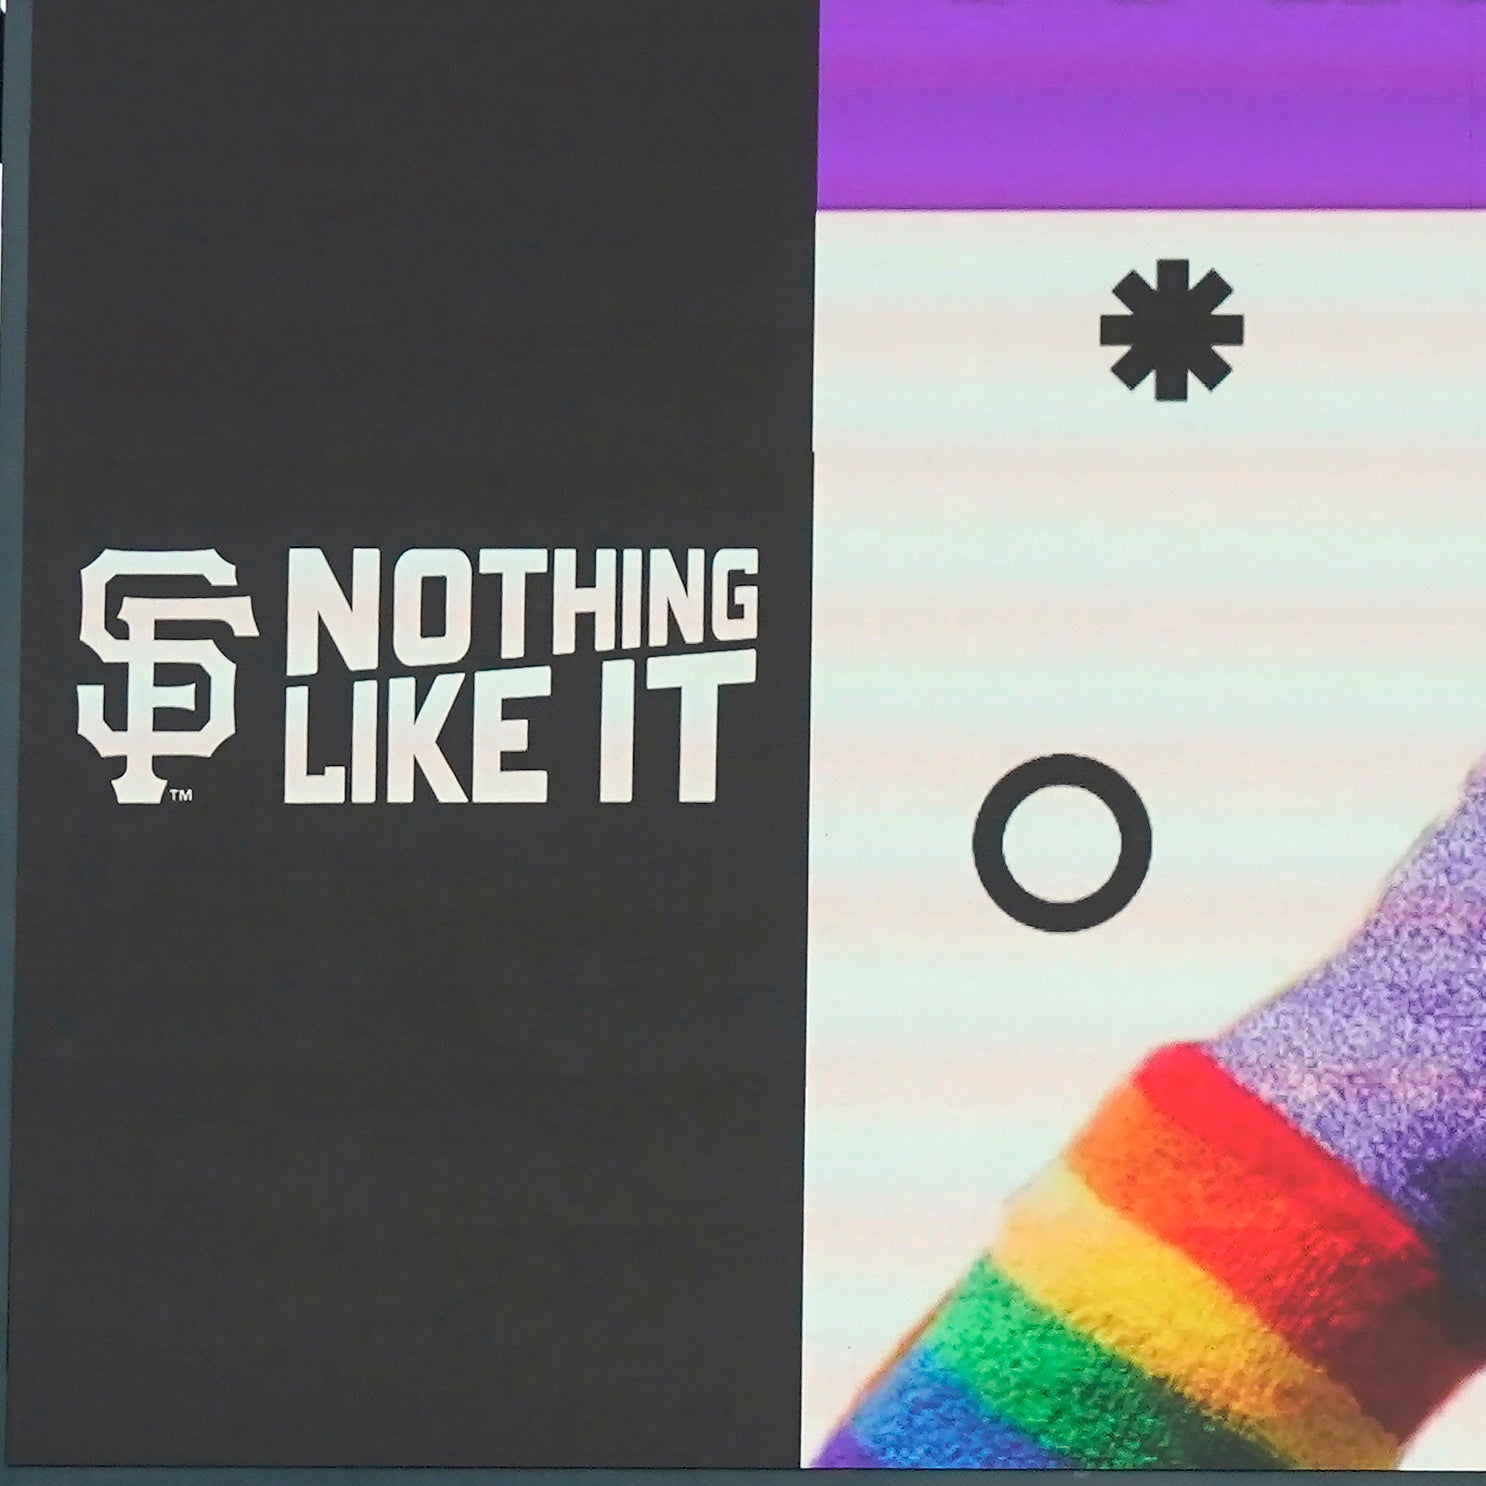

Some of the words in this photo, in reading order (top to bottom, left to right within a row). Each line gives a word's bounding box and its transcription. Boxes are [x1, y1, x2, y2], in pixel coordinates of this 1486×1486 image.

[285, 547, 759, 677] NOTHING
[284, 666, 552, 804] LIKE
[599, 648, 757, 804] IT
